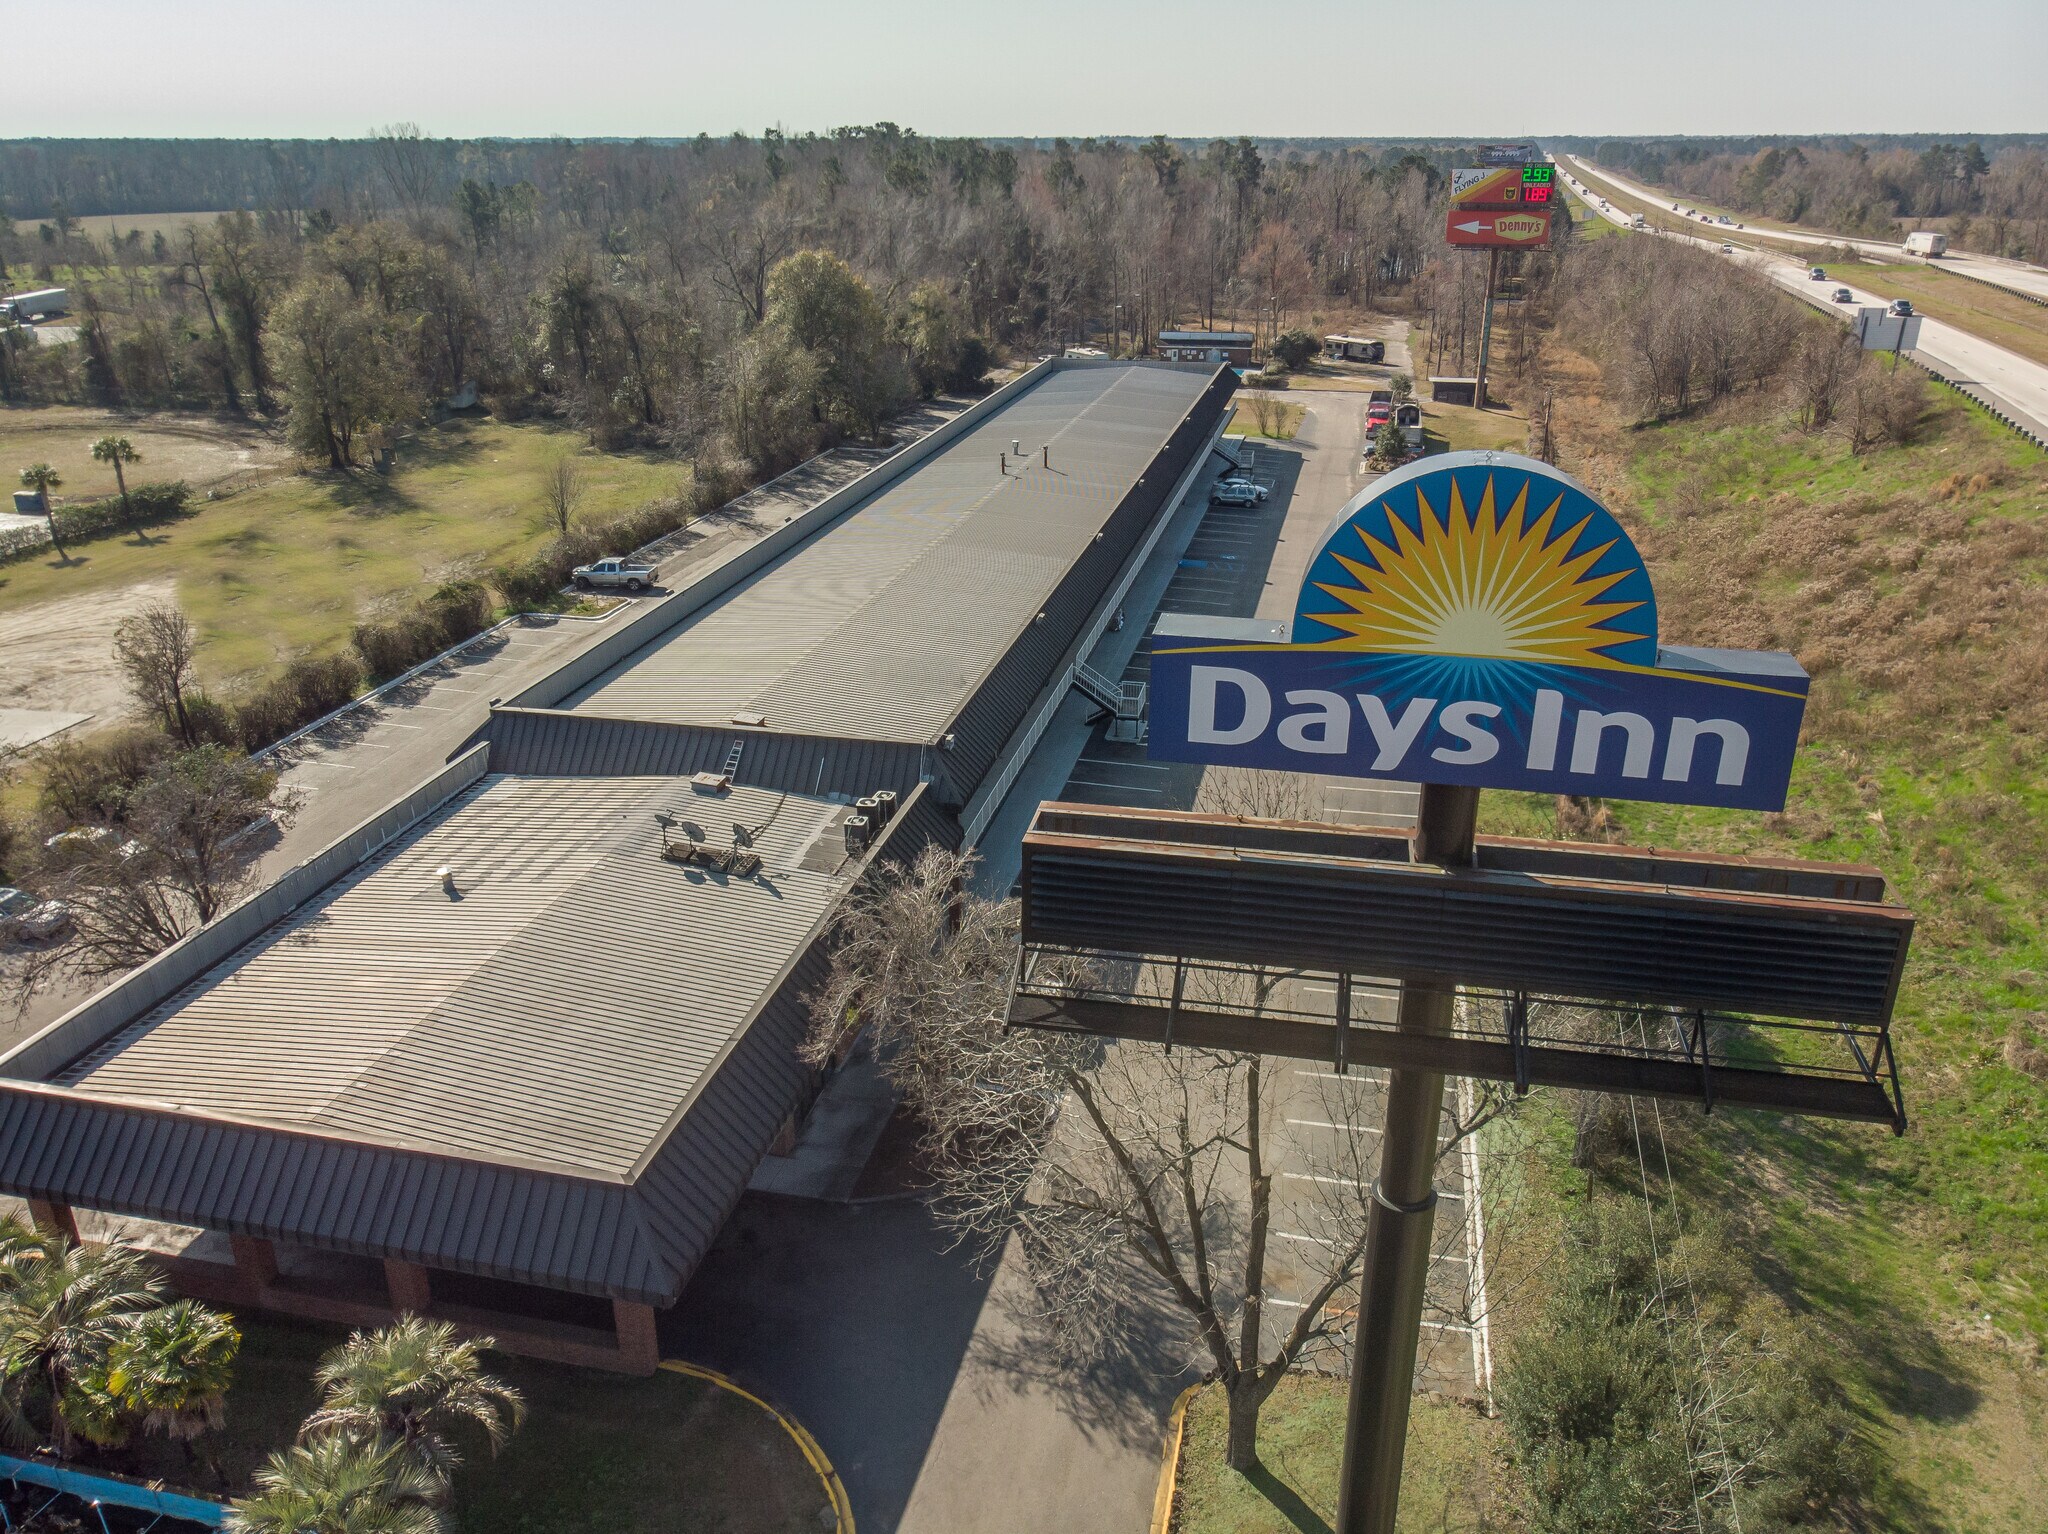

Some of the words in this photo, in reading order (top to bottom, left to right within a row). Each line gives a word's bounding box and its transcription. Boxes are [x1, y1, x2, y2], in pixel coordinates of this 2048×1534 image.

[1454, 175, 1480, 194] FLYING
[1499, 220, 1541, 233] Denny's
[1187, 664, 1502, 772] Days
[1525, 688, 1751, 787] Inn
